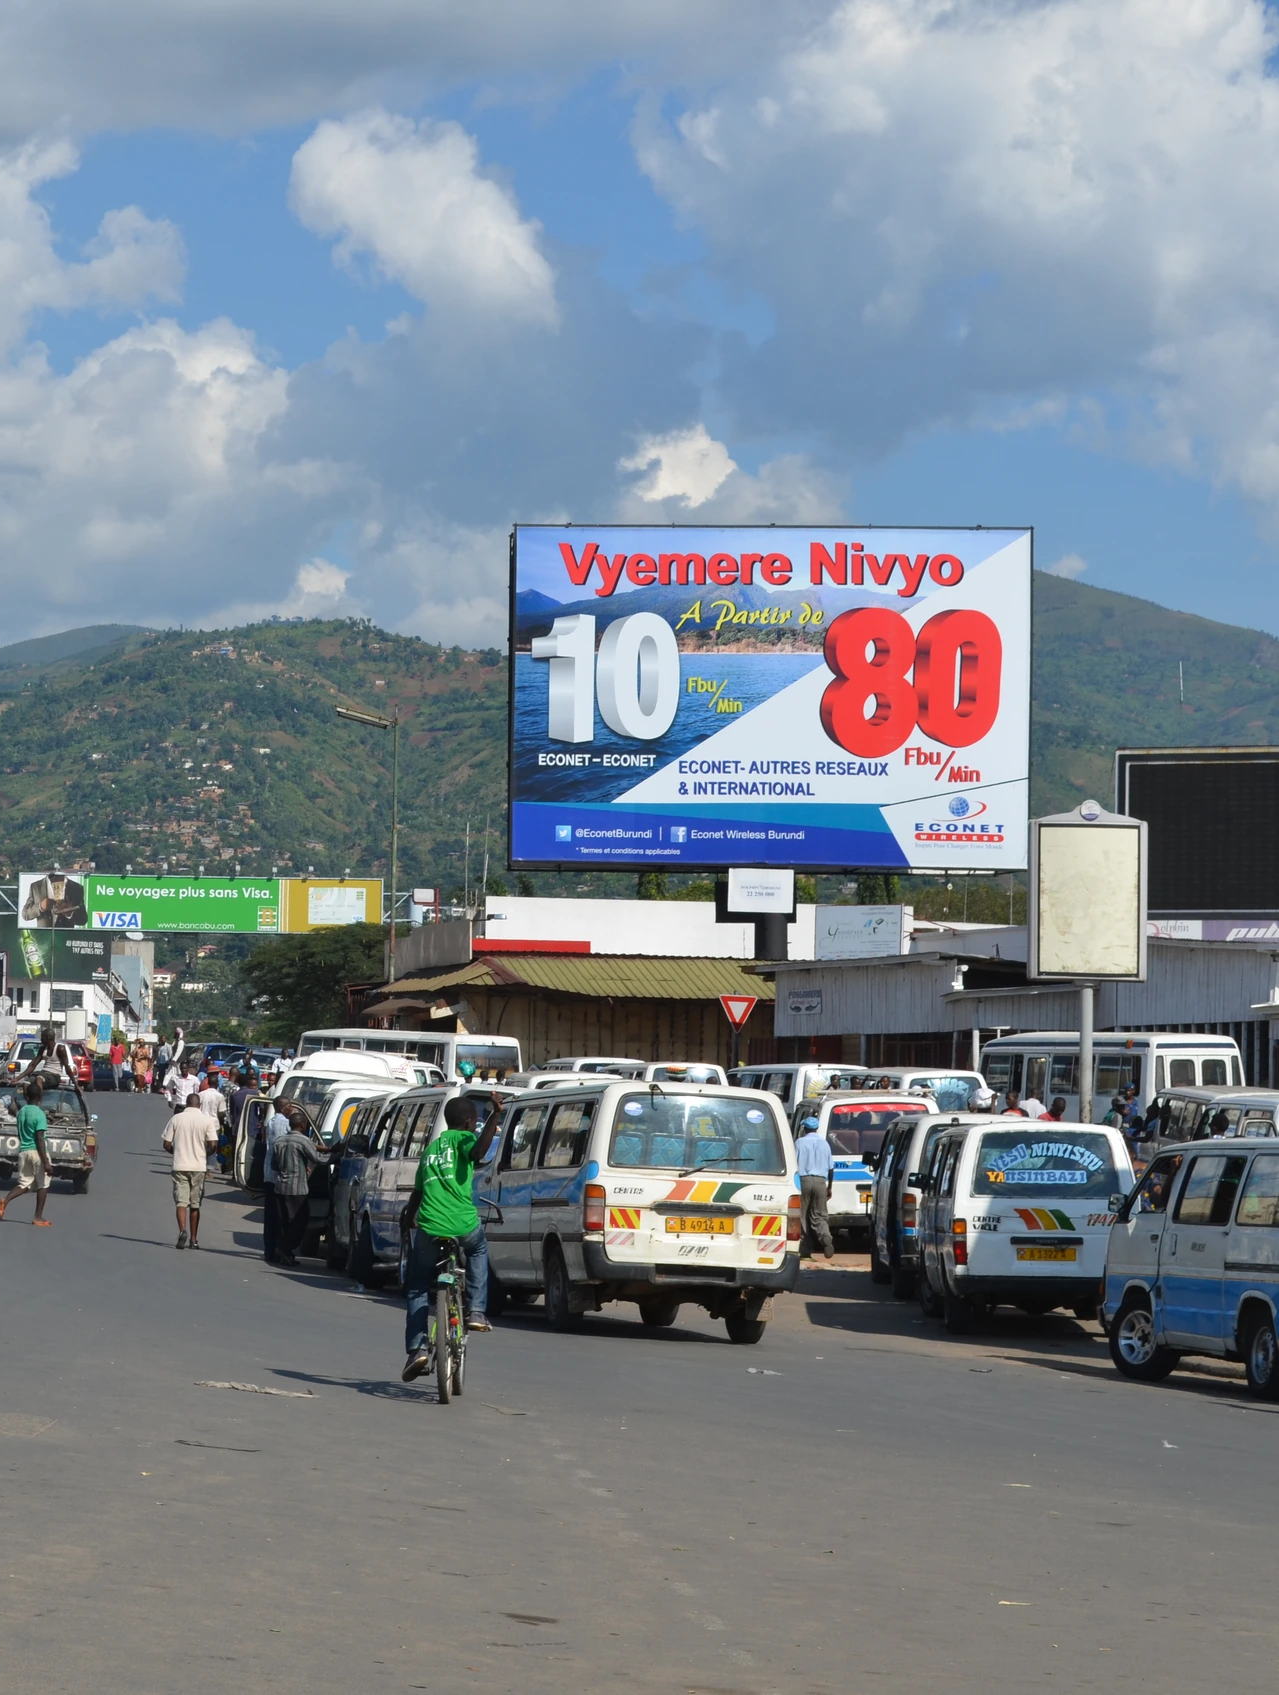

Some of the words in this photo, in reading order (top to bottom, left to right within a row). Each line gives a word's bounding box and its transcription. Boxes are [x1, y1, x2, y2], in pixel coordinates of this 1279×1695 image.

[559, 542, 793, 597] Vyemere
[809, 542, 964, 597] Nivyo
[676, 600, 701, 629] A
[711, 600, 792, 630] Partir
[799, 603, 824, 625] de
[531, 611, 680, 744] 10
[820, 607, 1003, 759] 80
[749, 761, 810, 775] AUTRES
[816, 762, 889, 776] RESEAUX
[678, 782, 689, 795] &
[693, 782, 815, 796] INTERNATIONAL
[576, 828, 652, 839] @EconetBurundi
[915, 823, 1004, 832] ECONET
[691, 830, 723, 840] Econet
[726, 830, 766, 840] Wireless
[768, 830, 804, 840] Burundi
[645, 848, 680, 856] applicables
[96, 884, 115, 896] Ne
[118, 886, 176, 899] voyagez
[179, 886, 205, 899] plus
[209, 888, 238, 898] sans
[242, 887, 273, 899] Visa.
[97, 912, 140, 928] VISA
[158, 921, 235, 930] www.bancobu.com
[987, 1143, 1029, 1172] YESU
[1030, 1142, 1104, 1171] NINYISHU
[680, 1218, 686, 1230] B
[691, 1219, 714, 1230] 4914
[719, 1220, 725, 1231] A
[1030, 1250, 1034, 1259] A
[1038, 1250, 1058, 1259] 1322
